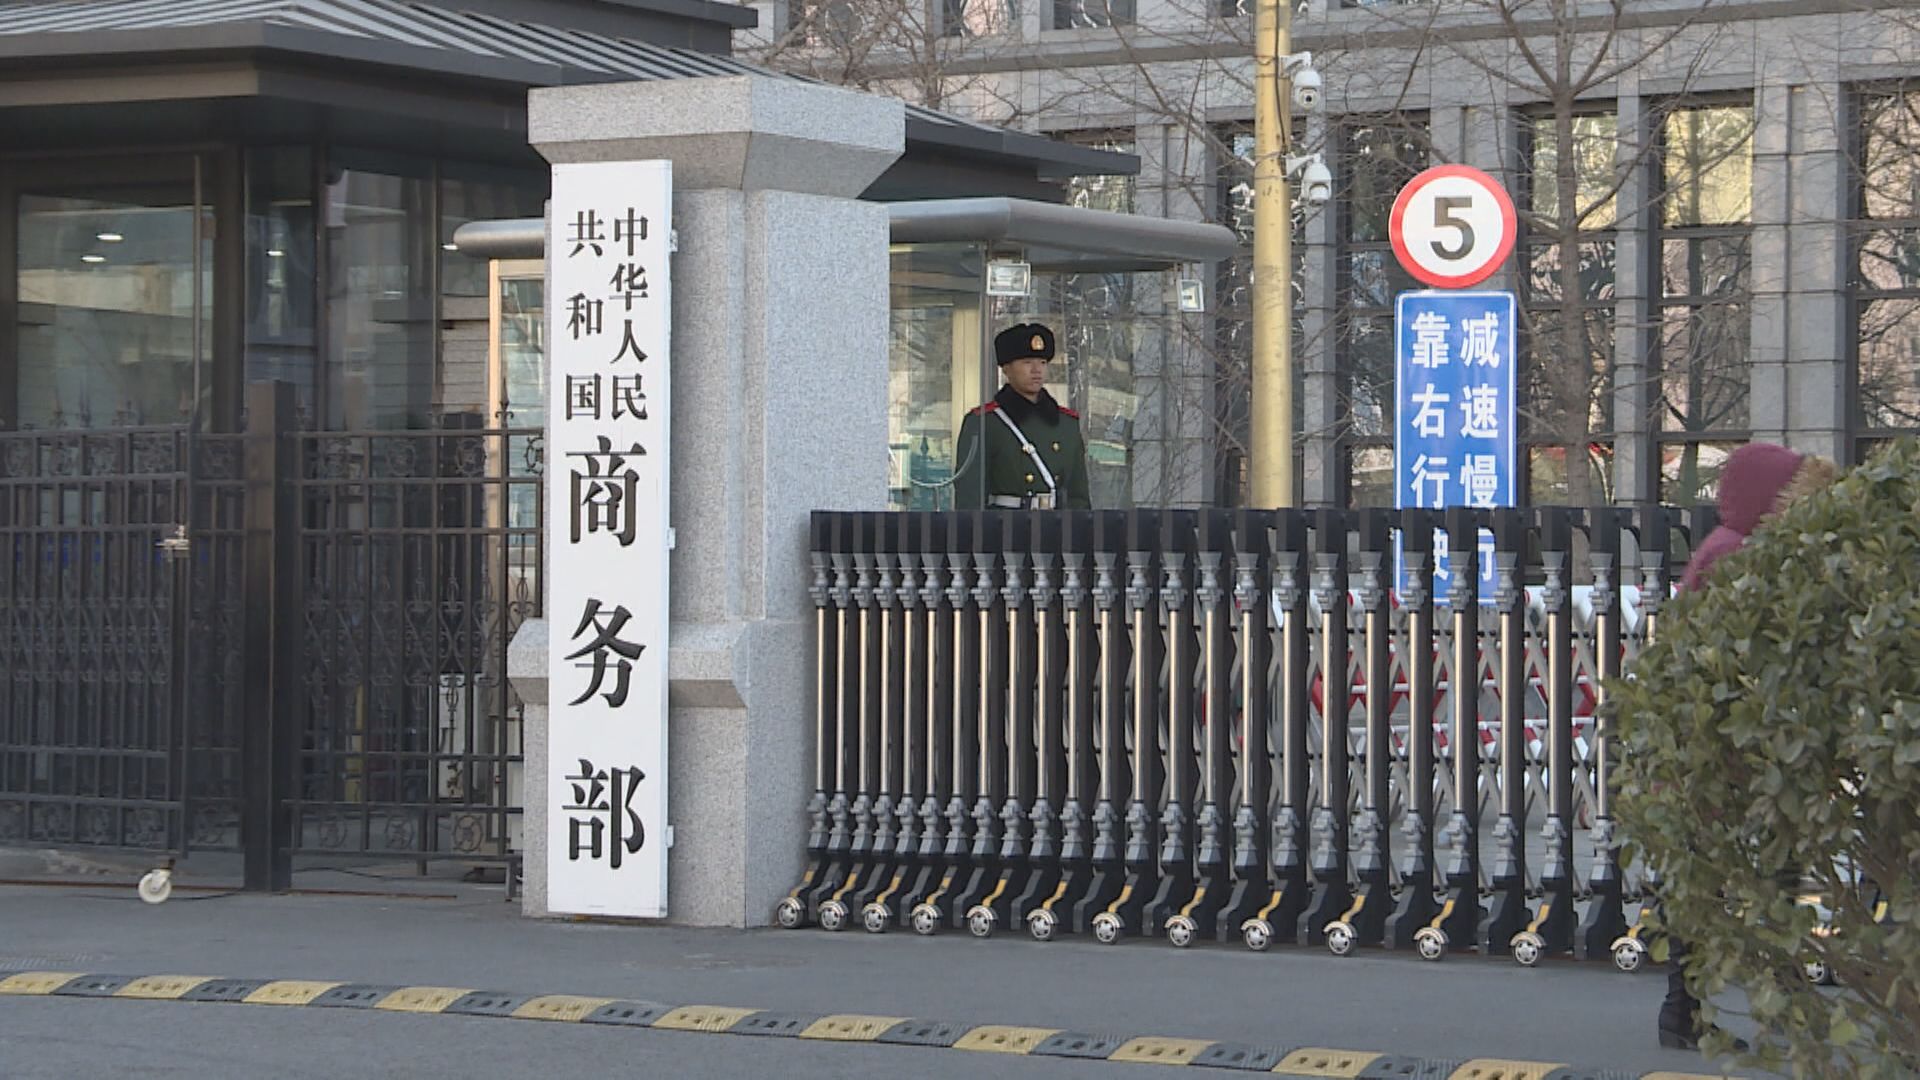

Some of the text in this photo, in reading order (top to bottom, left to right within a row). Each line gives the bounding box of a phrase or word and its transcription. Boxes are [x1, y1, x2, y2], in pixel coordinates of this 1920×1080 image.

[565, 209, 606, 422] 共和国
[609, 207, 649, 422] 中华人民
[1430, 196, 1476, 261] 5
[562, 434, 648, 870] 商务部
